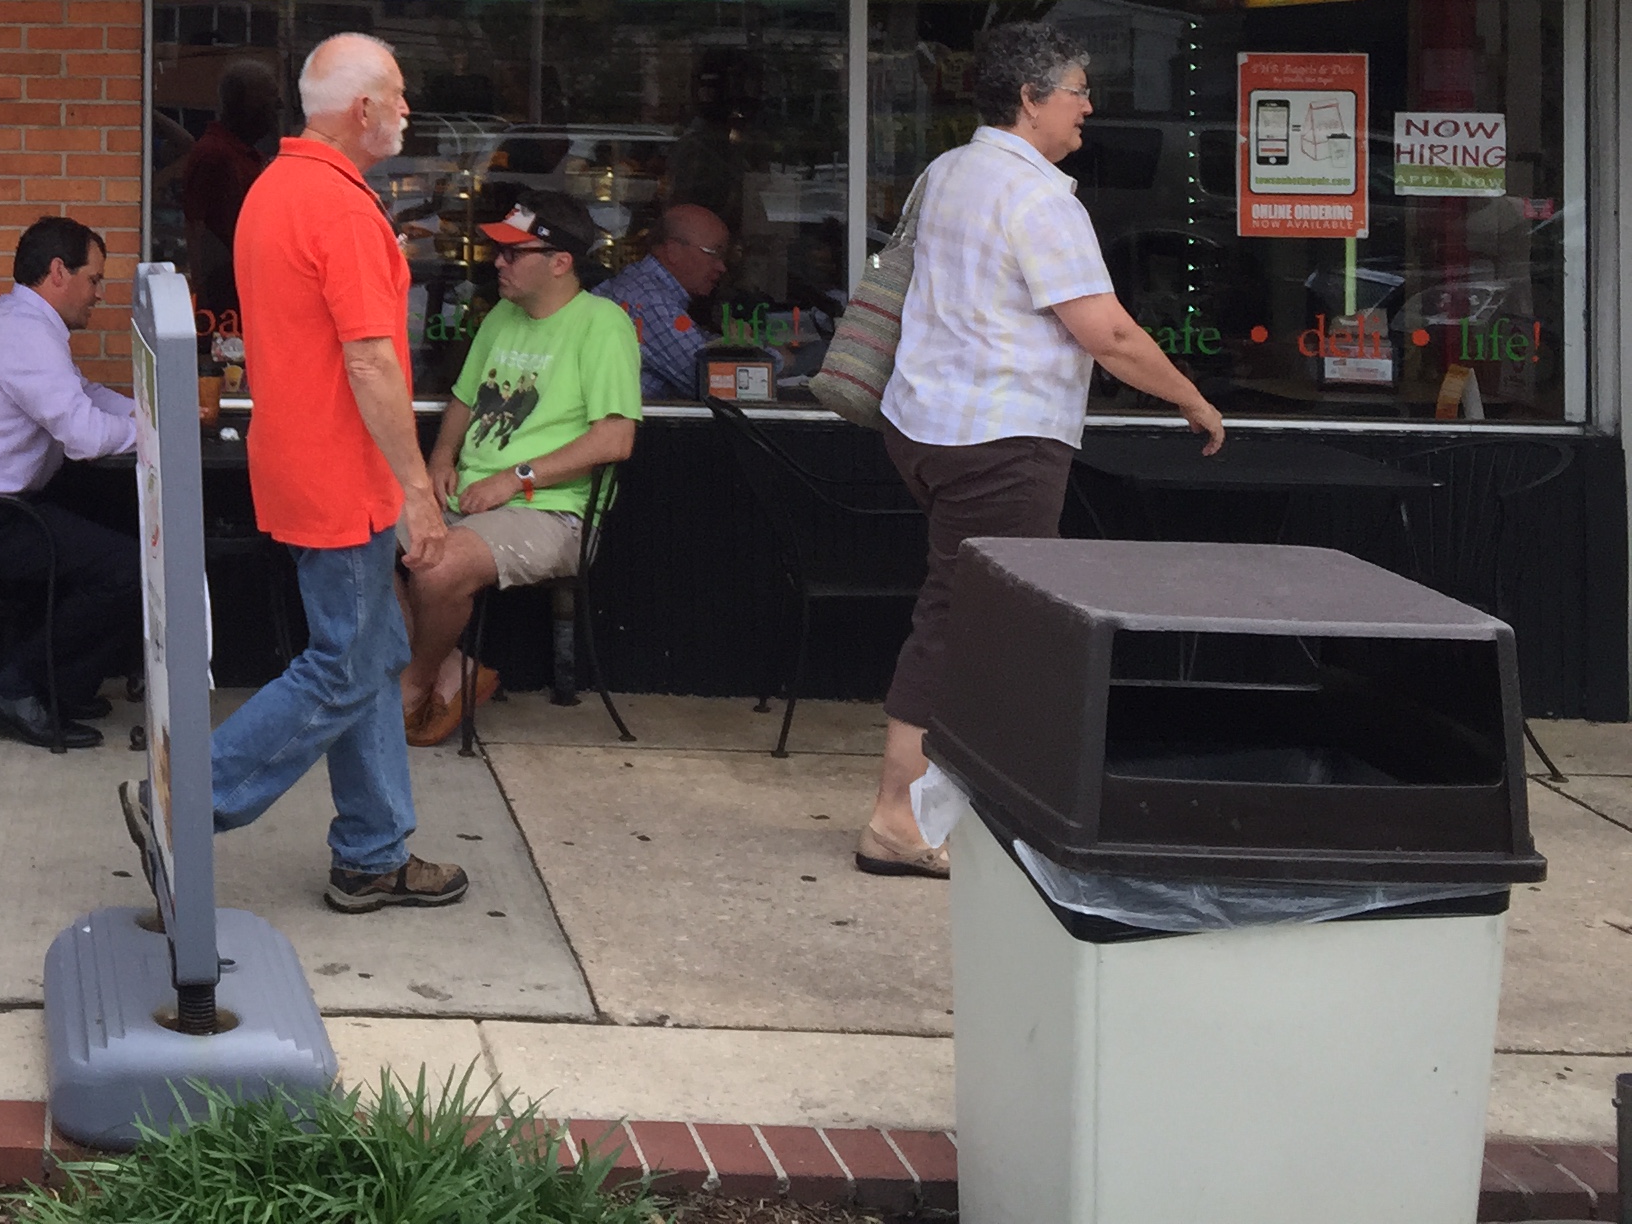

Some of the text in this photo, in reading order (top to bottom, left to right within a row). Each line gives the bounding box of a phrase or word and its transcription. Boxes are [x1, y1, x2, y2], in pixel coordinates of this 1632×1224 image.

[1405, 119, 1500, 139] NOW
[1396, 143, 1506, 168] HIRING
[1395, 175, 1503, 189] APPLY NOW
[1252, 204, 1353, 220] ONLINE ORDERING
[1252, 220, 1353, 230] NOW AVAILABLE
[722, 302, 800, 348] life!
[1142, 307, 1541, 363] afe deli life!
